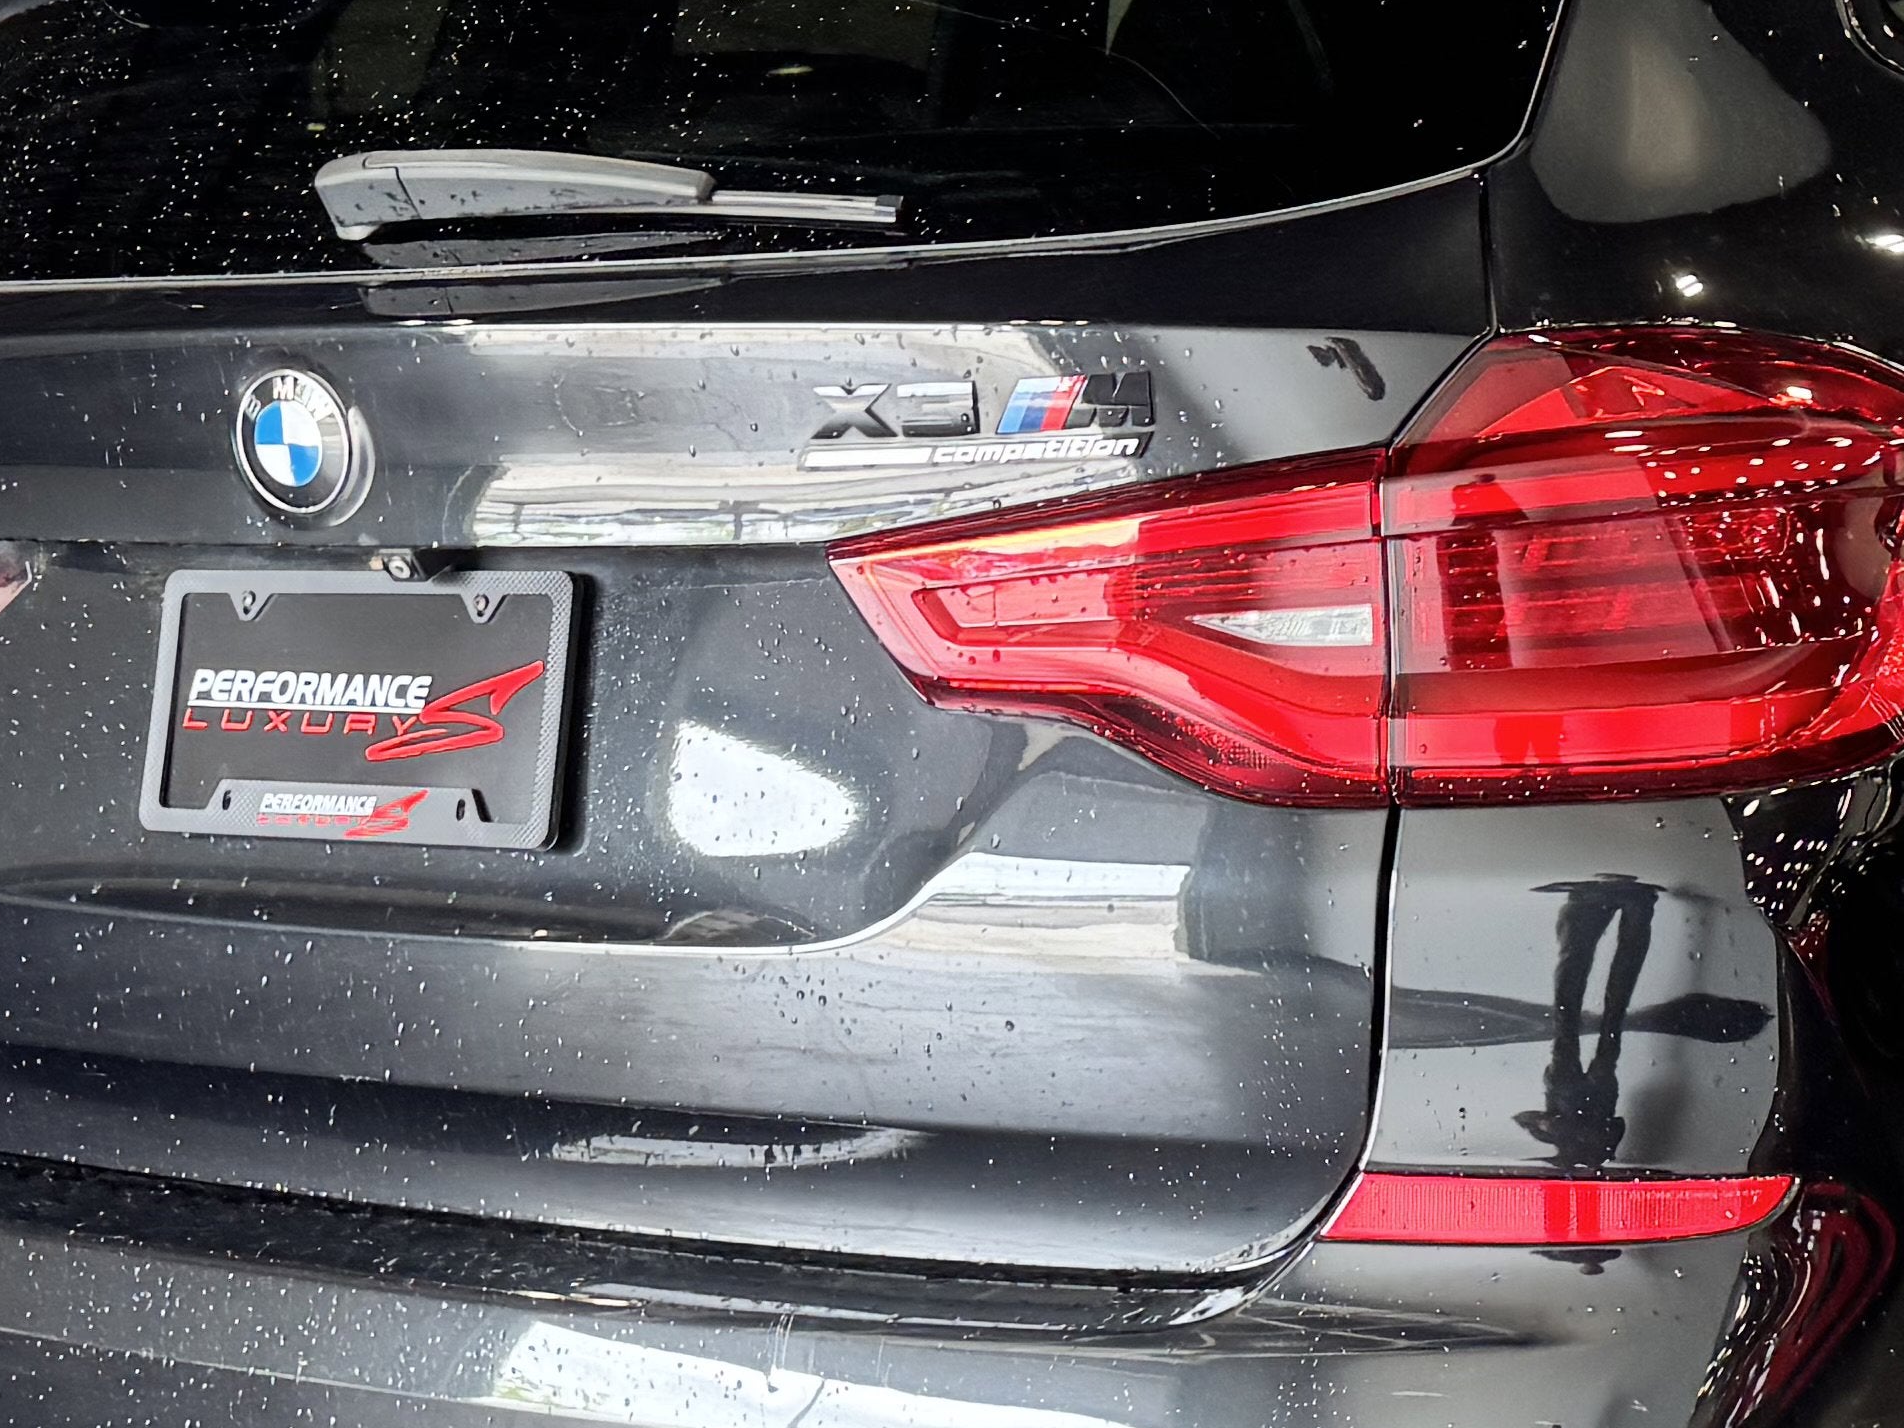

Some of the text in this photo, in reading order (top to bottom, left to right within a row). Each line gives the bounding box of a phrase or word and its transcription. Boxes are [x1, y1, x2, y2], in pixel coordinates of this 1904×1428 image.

[809, 370, 1156, 439] X3 M
[933, 435, 1140, 464] competition
[187, 668, 433, 712] PERFORMANCE
[182, 707, 421, 737] LUXURY
[259, 792, 378, 815] PERFORMANCE
